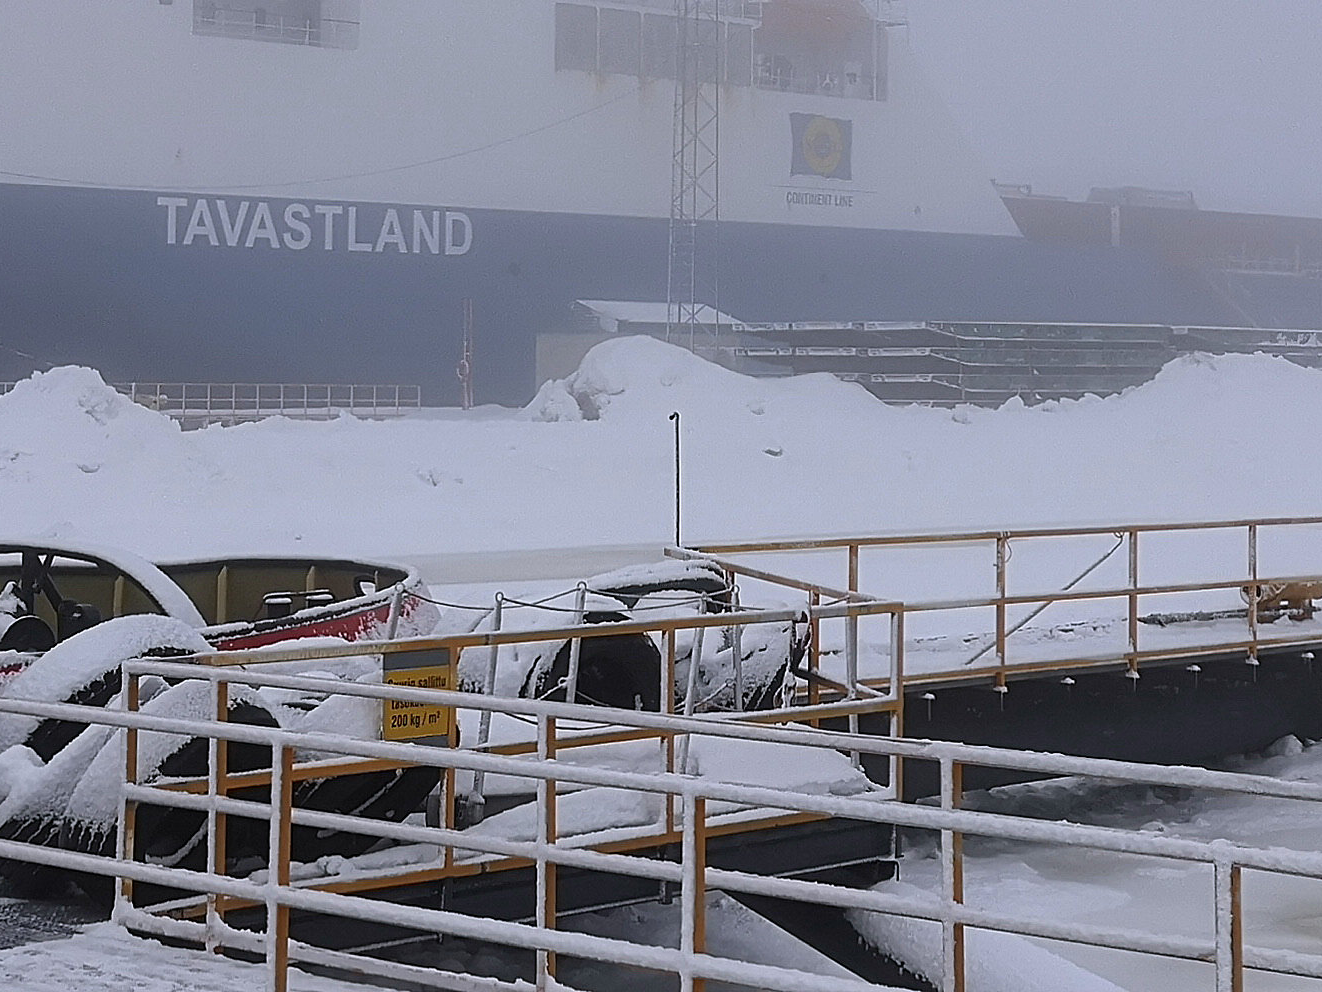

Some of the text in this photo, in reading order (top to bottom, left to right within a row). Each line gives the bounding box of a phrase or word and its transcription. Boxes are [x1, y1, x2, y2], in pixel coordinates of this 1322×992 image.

[786, 191, 854, 208] CONTINENT LINE
[156, 196, 474, 255] TAVASTLAND
[418, 675, 447, 688] sallittu
[391, 714, 408, 728] 200
